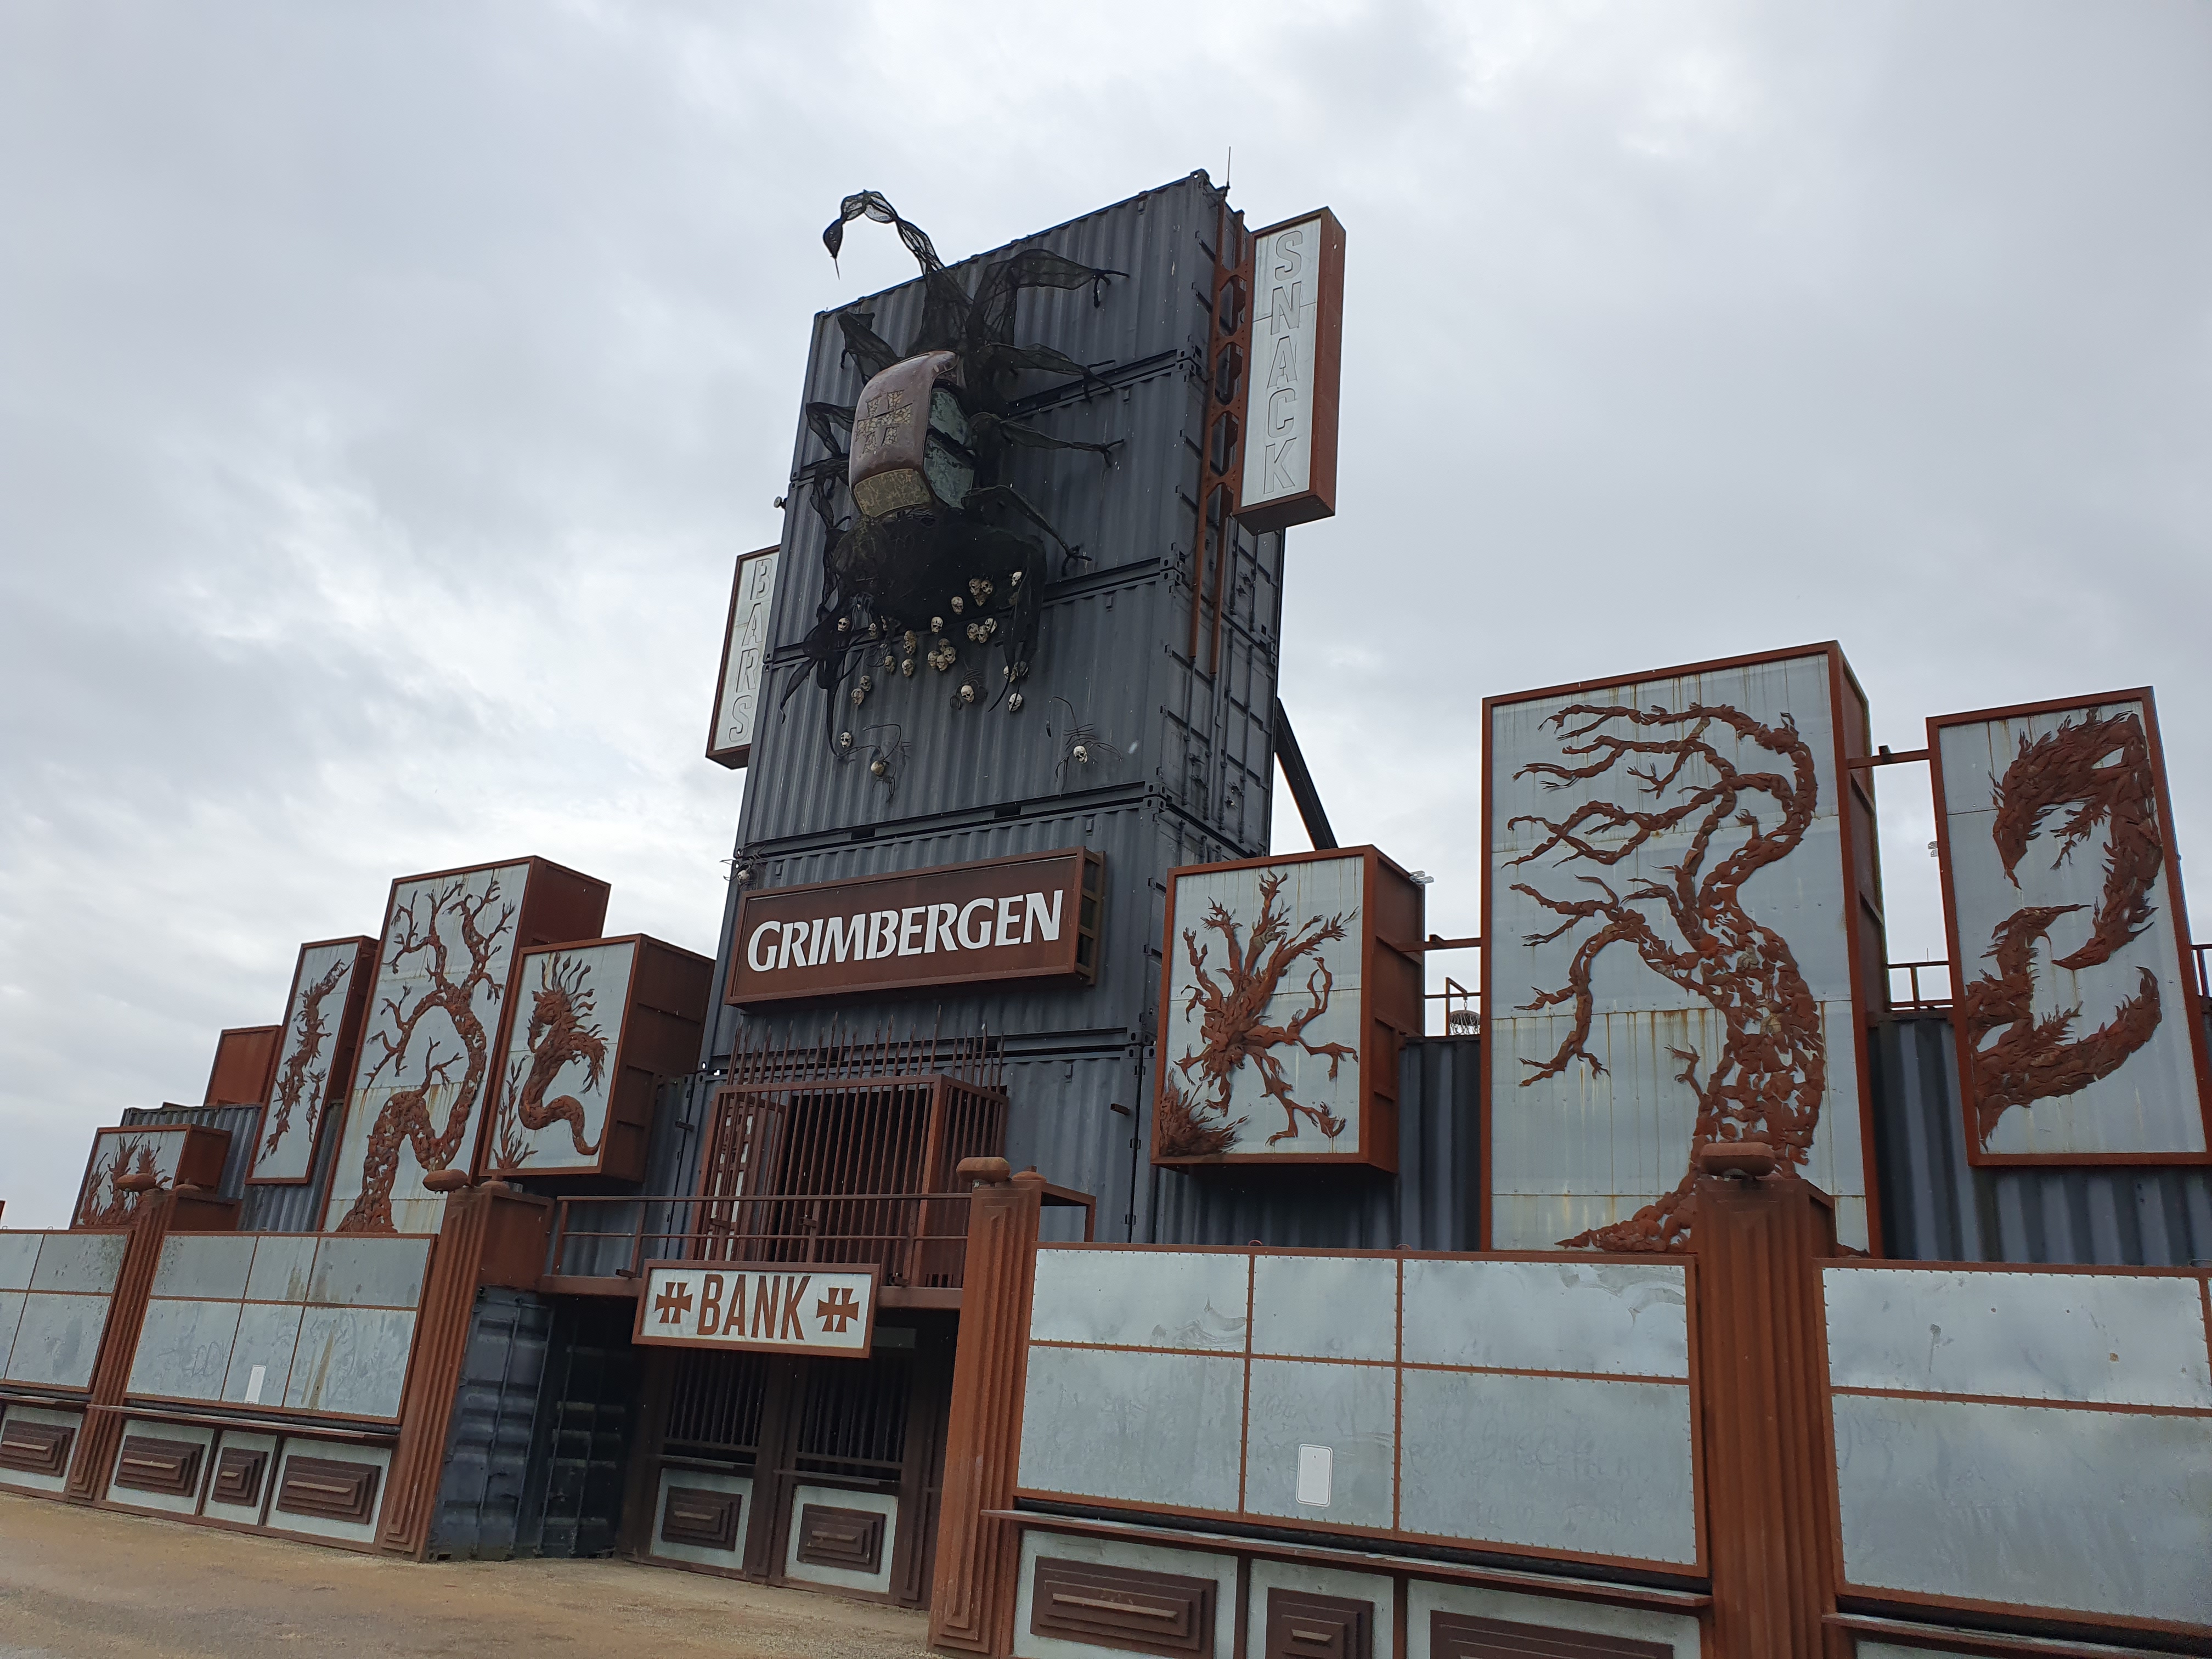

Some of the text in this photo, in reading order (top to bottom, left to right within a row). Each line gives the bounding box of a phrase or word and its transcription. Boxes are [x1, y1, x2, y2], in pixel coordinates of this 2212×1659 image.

[1263, 230, 1303, 495] SNACK
[729, 558, 773, 742] BARS
[747, 889, 1063, 972] GRIMBERGEN
[696, 1273, 811, 1340] BANK
